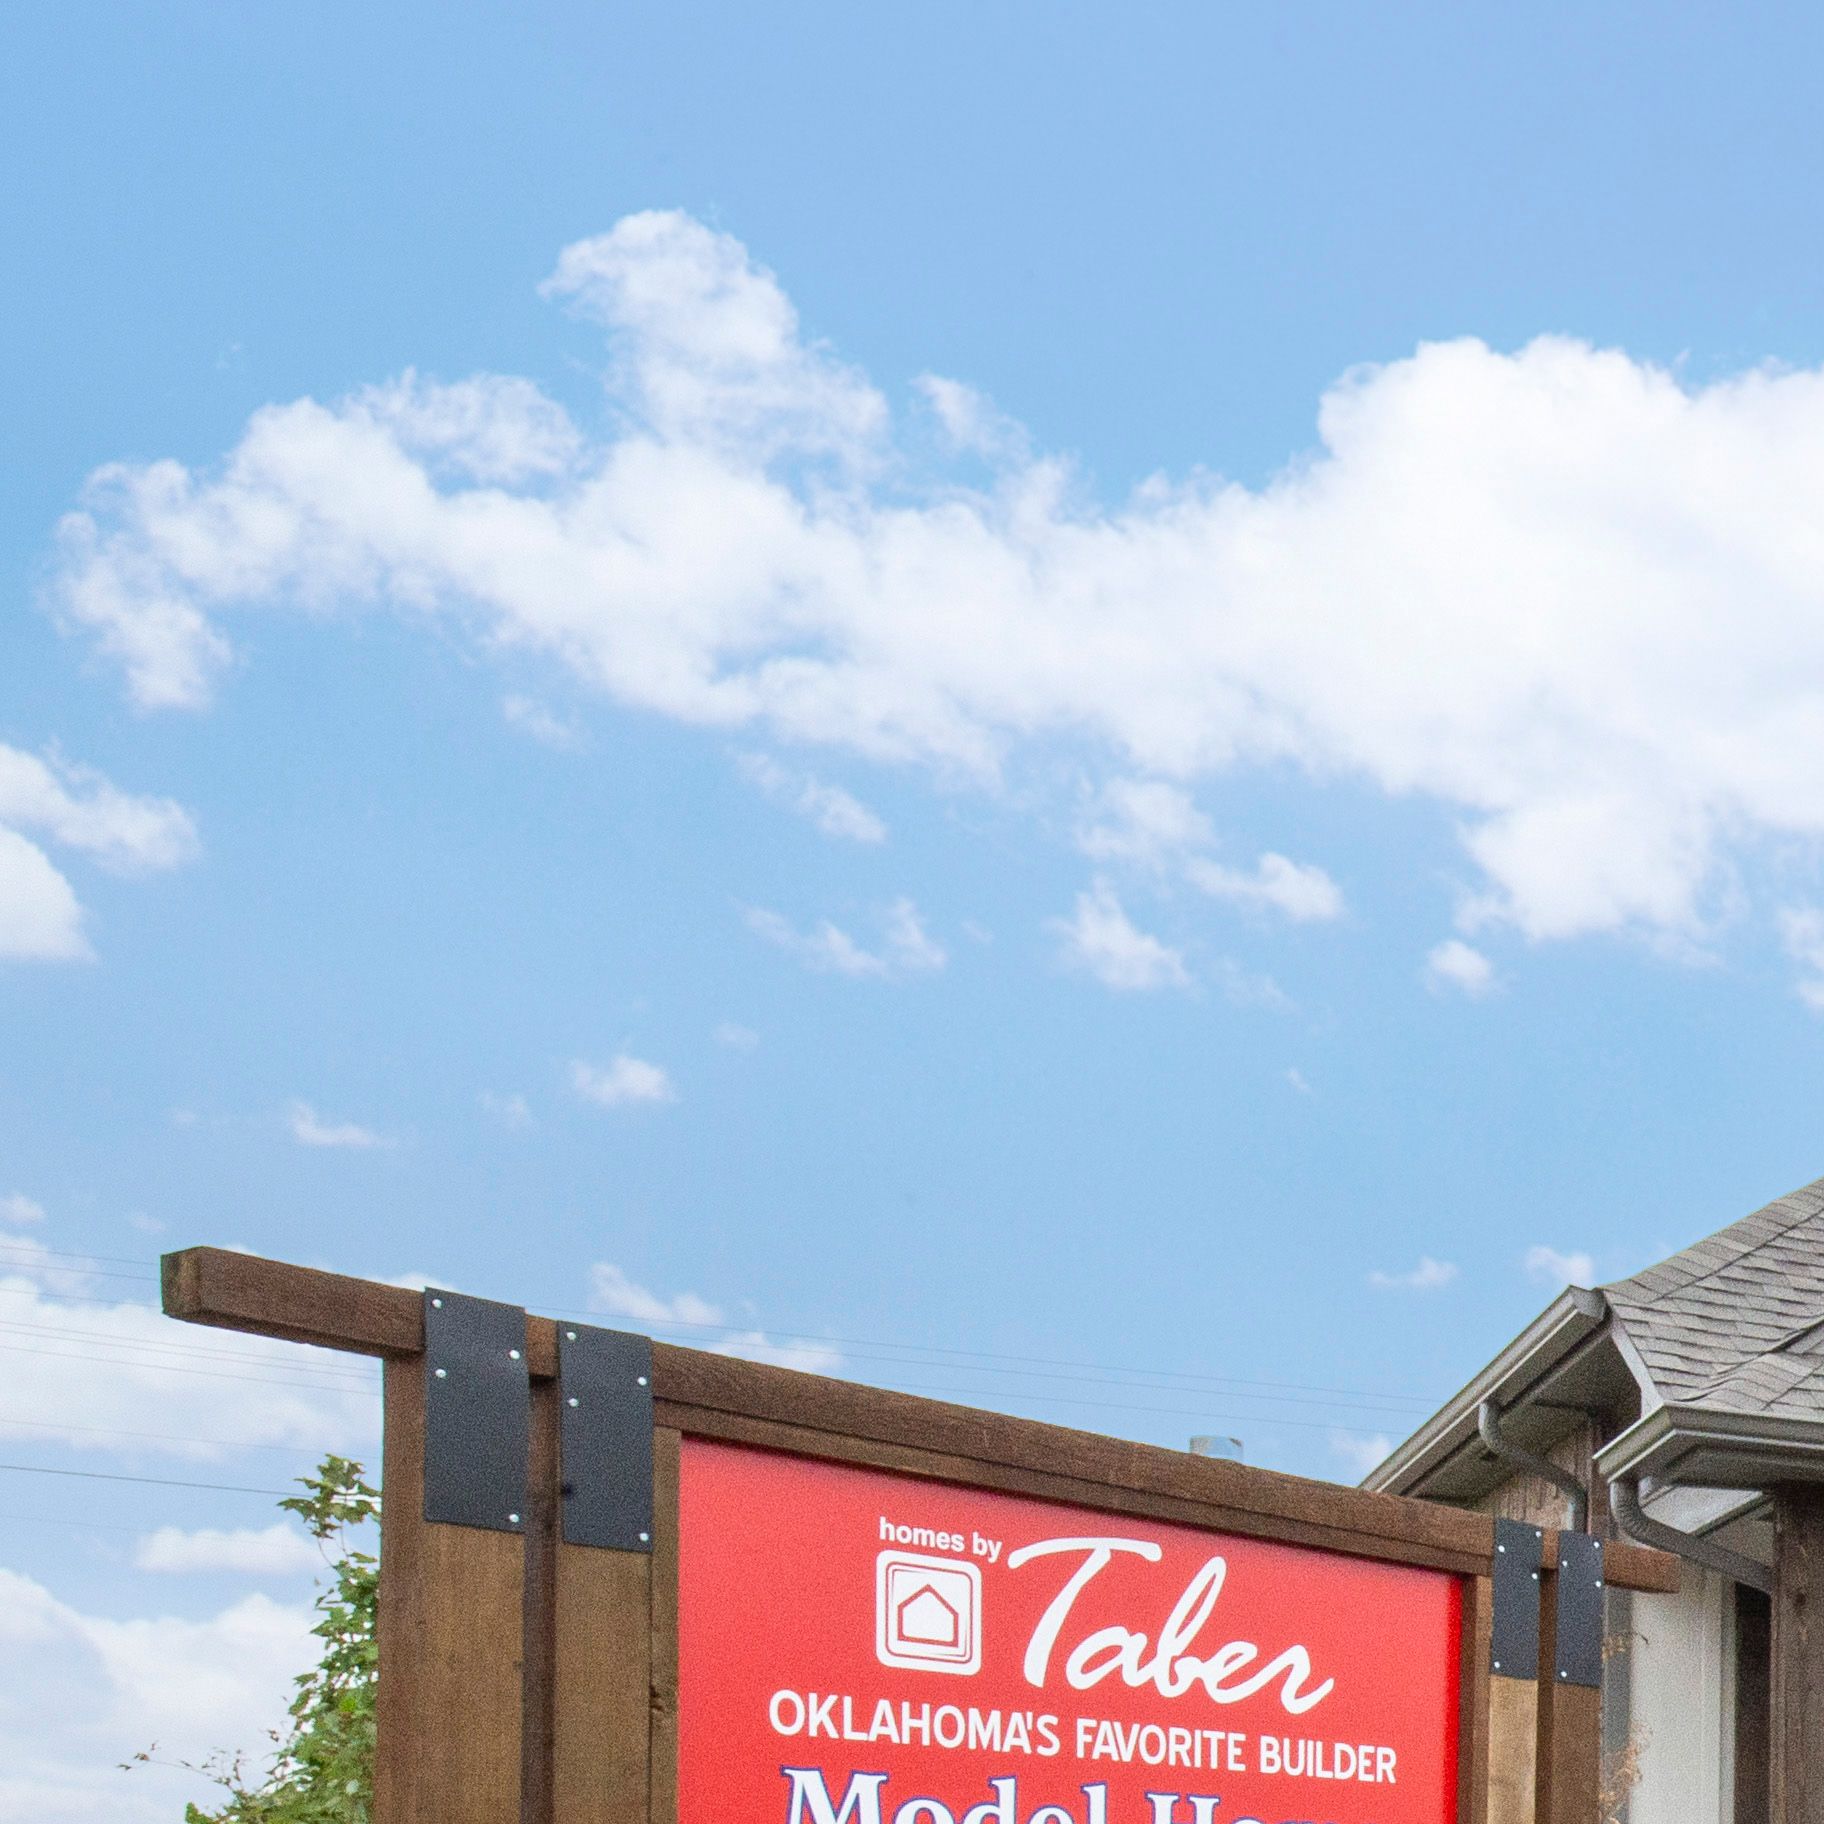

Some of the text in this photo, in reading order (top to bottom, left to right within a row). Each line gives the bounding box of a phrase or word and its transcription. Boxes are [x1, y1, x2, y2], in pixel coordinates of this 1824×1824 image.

[878, 1516, 1002, 1563] homes by
[1007, 1537, 1334, 1714] Taber
[768, 1689, 1397, 1784] OKLAHOMA'S FAVORITE BUILDER
